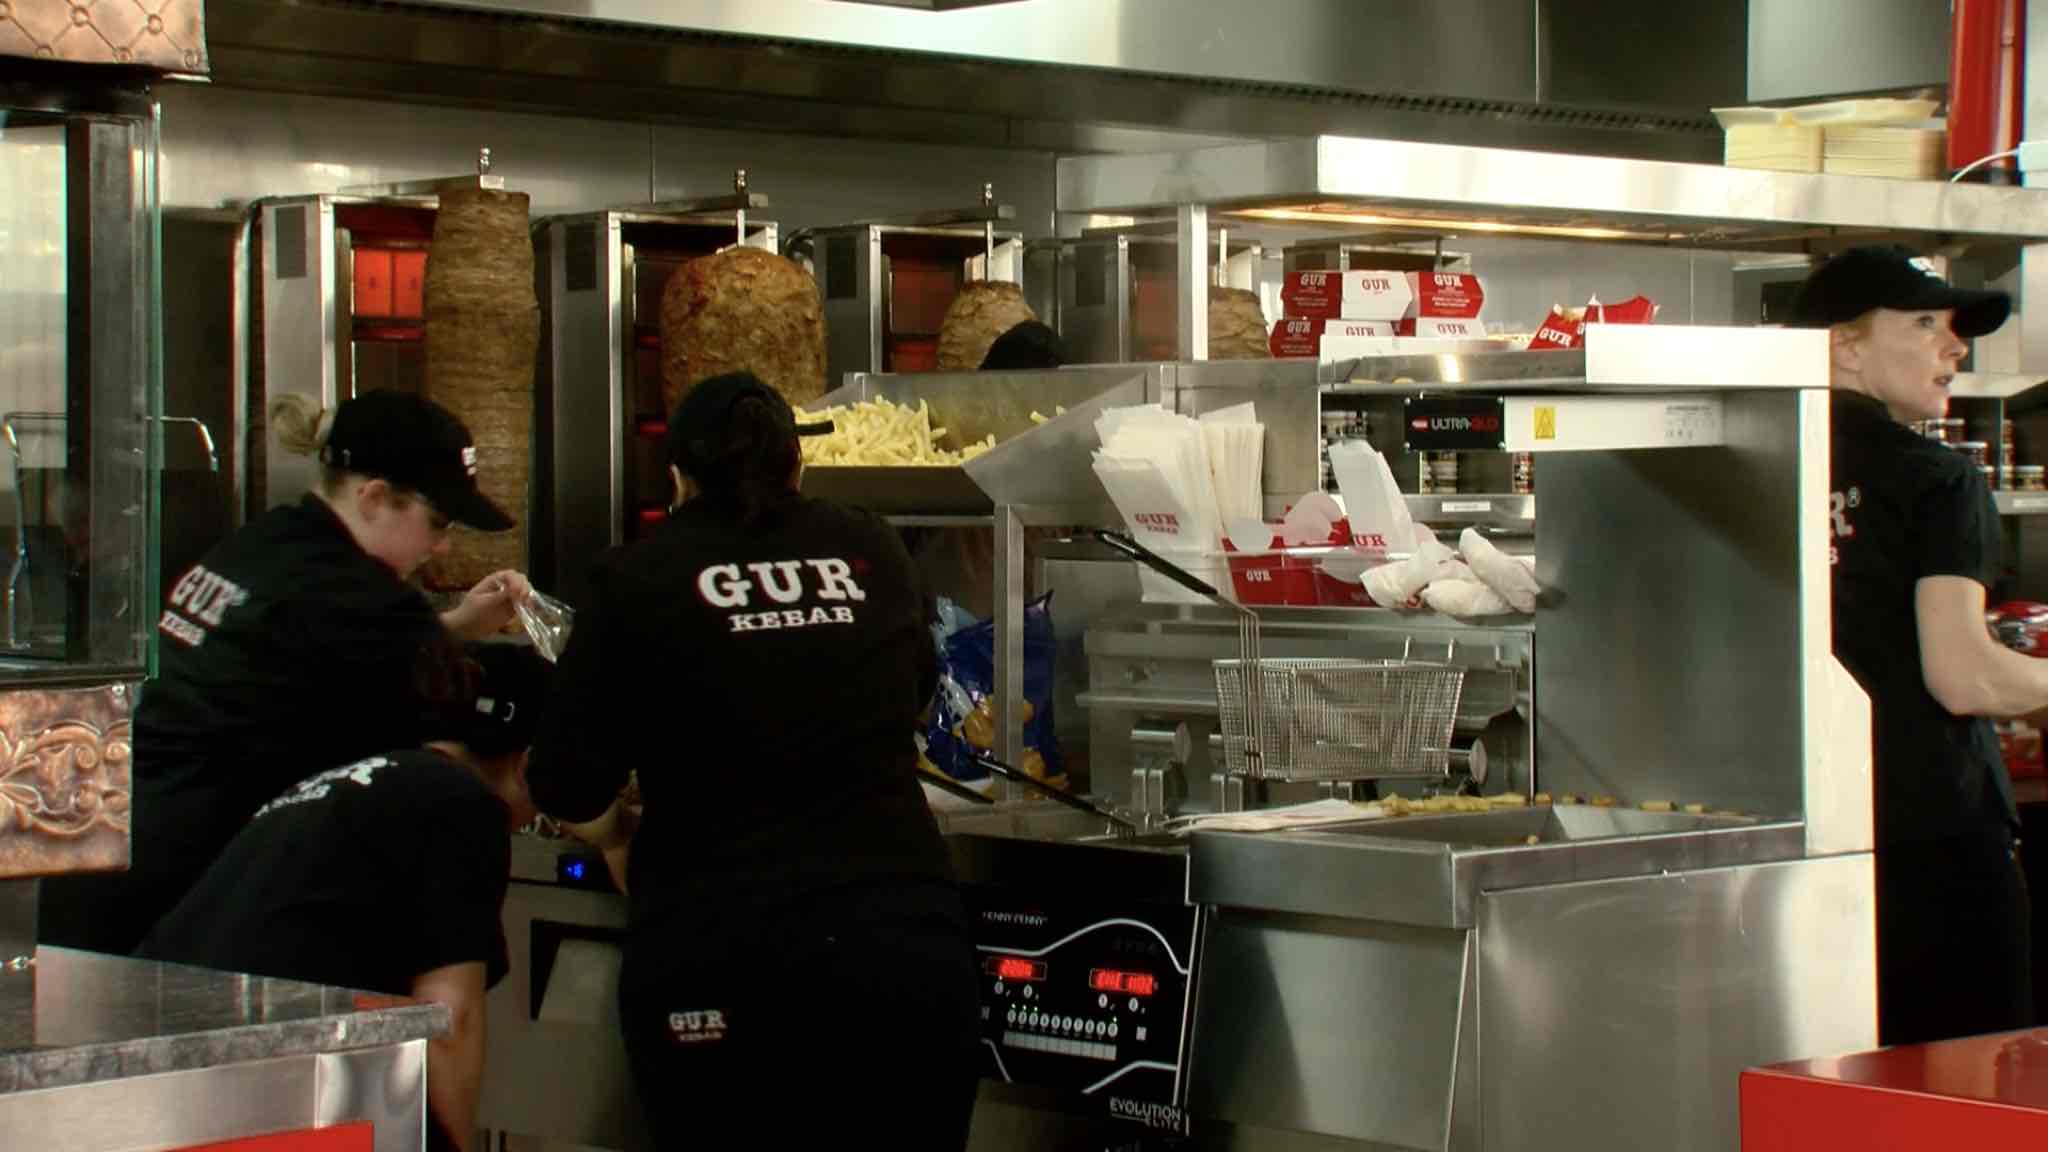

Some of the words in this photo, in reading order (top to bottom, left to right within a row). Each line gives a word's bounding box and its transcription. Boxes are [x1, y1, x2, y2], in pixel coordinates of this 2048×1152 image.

[1300, 274, 1327, 287] GUR
[1361, 278, 1392, 291] GUR
[1434, 274, 1463, 287] GUR
[1437, 323, 1470, 335] GUR
[1539, 327, 1573, 347] GUR
[1134, 512, 1179, 527] GUR
[698, 557, 866, 608] GUR
[1246, 569, 1272, 582] GUR
[728, 606, 855, 633] KEBAB
[669, 1009, 728, 1032] GUR
[1110, 1096, 1181, 1121] EVOLUTION
